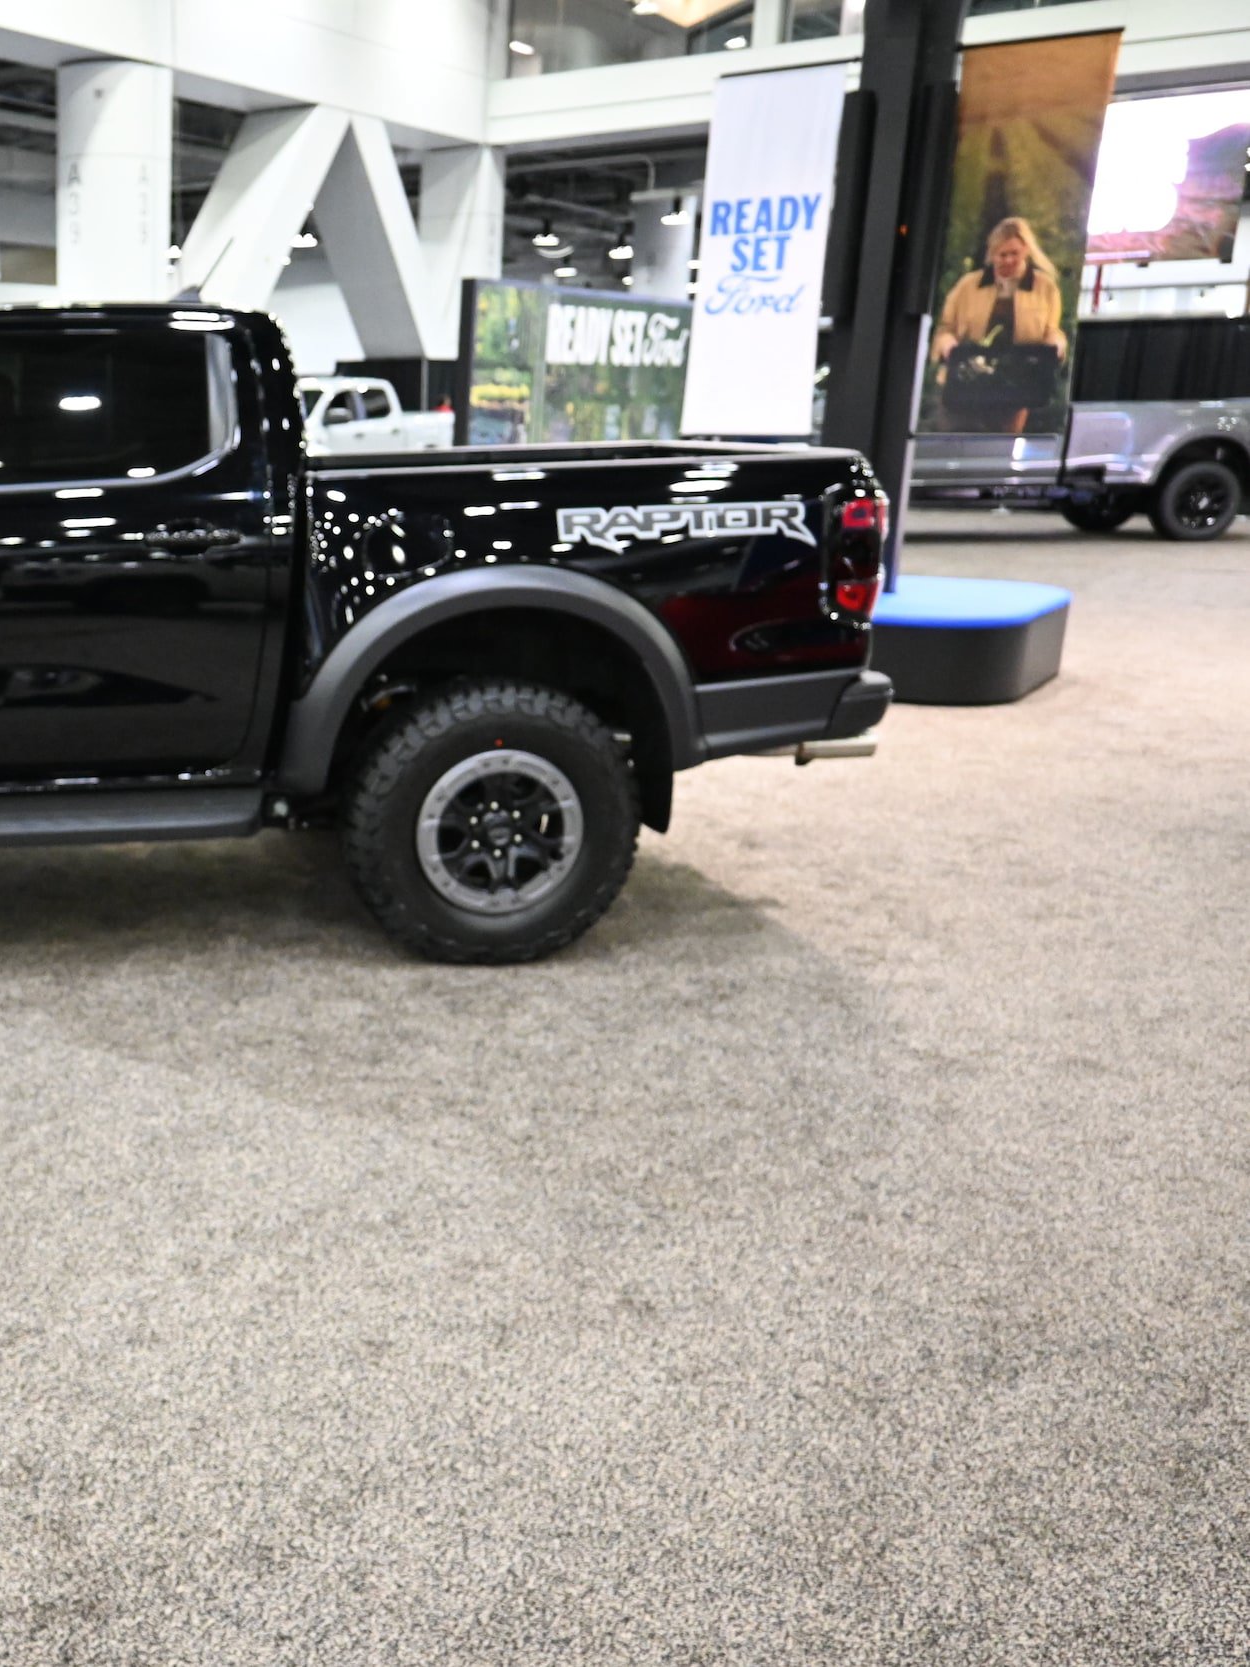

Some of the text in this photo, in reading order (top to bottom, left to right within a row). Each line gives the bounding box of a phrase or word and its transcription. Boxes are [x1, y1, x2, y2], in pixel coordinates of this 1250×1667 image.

[710, 193, 823, 236] READY
[730, 234, 791, 272] SET
[704, 273, 806, 315] Ford
[545, 303, 690, 367] READY SET Ford
[556, 500, 817, 554] RAPTOR
